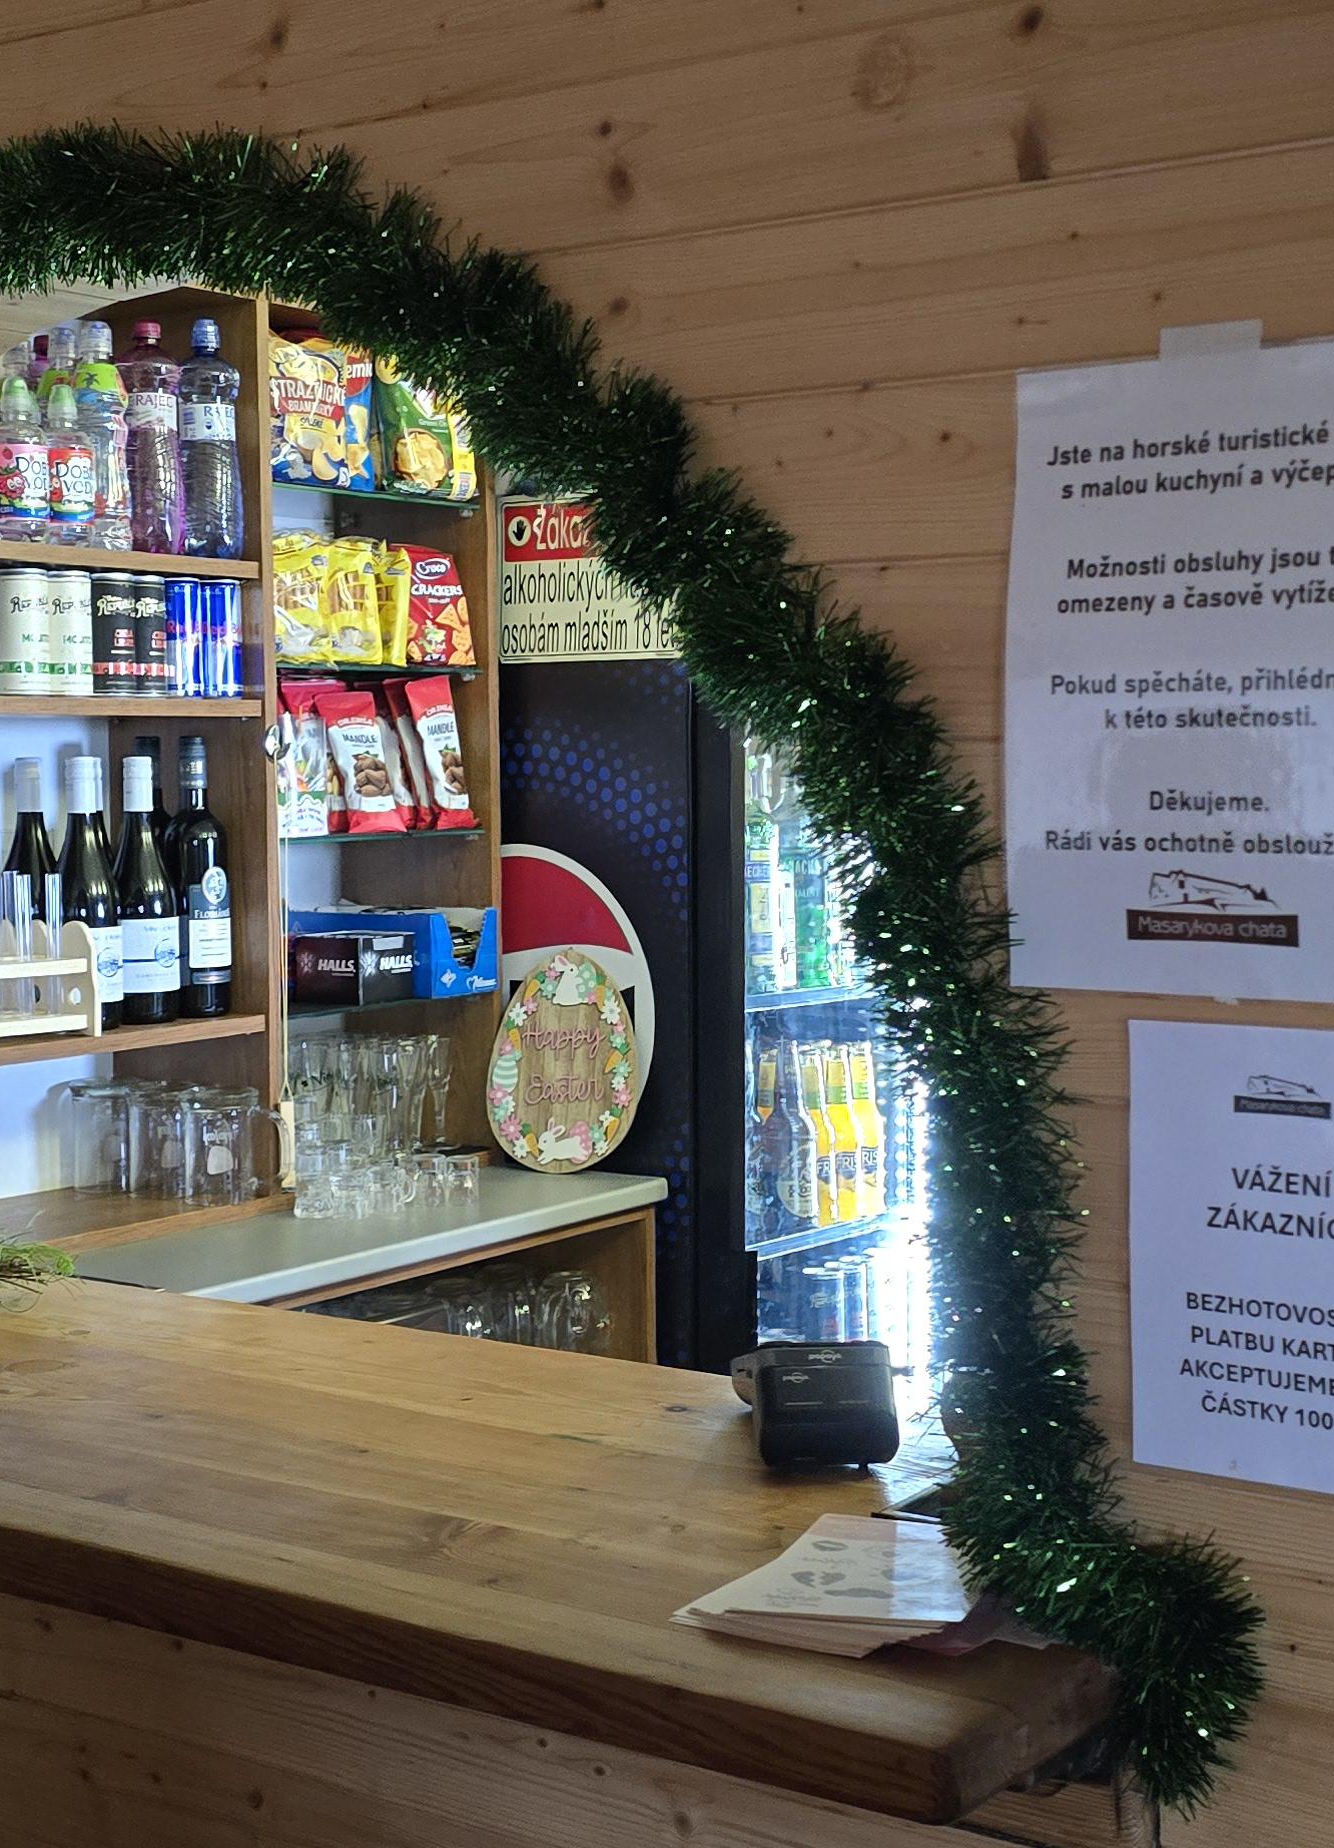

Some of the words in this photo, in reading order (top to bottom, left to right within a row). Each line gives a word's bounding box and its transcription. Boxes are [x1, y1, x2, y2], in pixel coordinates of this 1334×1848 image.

[135, 394, 173, 410] RAJEC
[1046, 445, 1092, 466] Jste
[1099, 445, 1124, 463] na
[1132, 429, 1211, 459] horské
[1219, 419, 1329, 452] turistické
[1061, 482, 1074, 499] s
[1080, 475, 1148, 499] malou
[1155, 463, 1244, 495] kuchyní
[1250, 469, 1264, 485] a
[1067, 553, 1166, 579] Možnosti
[1173, 550, 1263, 574] obsluhy
[1268, 547, 1321, 573] jsou
[411, 583, 464, 597] CRACKERS
[1056, 592, 1156, 616] omezeny
[1162, 593, 1175, 610] a
[1183, 582, 1263, 609] časově
[502, 611, 560, 655] osobám
[564, 608, 628, 653] mladším
[634, 607, 652, 650] 18
[1050, 673, 1117, 695] Pokud
[1124, 669, 1233, 698] spěcháte,
[427, 721, 455, 736] MANDLE
[1104, 708, 1117, 729] k
[1124, 706, 1168, 729] této
[1174, 704, 1317, 730] skutečnosti.
[342, 733, 378, 745] MANDLE
[1149, 789, 1270, 816] Děkujeme.
[1045, 829, 1091, 851] Rádi
[1098, 829, 1136, 851] vás
[1144, 831, 1235, 853] ochotně
[1138, 915, 1234, 938] Masarykova
[1238, 921, 1287, 939] chata
[317, 958, 356, 972] HALLS
[379, 954, 413, 971] HALLS
[522, 1020, 607, 1060] Happy
[524, 1072, 605, 1105] Easter
[1231, 1163, 1333, 1198] VÁŽENÍ
[1191, 1325, 1275, 1353] PLATBU
[1201, 1390, 1289, 1424] ČÁSTKY
[1295, 1408, 1334, 1431] 100
